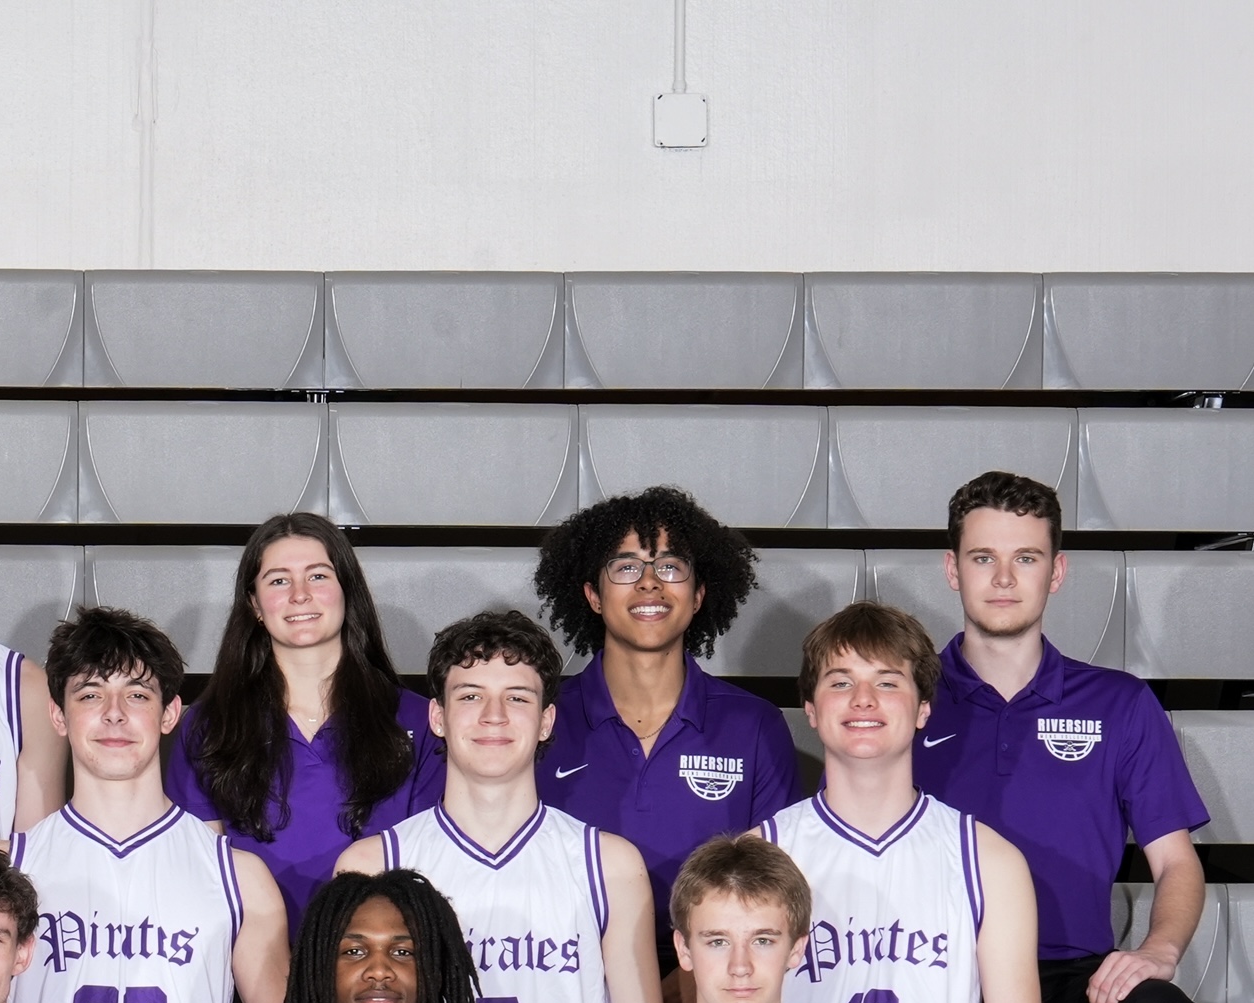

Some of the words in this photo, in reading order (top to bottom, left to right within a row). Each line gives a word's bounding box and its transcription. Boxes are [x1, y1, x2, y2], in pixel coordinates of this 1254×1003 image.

[1038, 718, 1102, 733] RIVERSIDE
[680, 755, 743, 773] RIVERSIDE
[466, 928, 580, 974] irates
